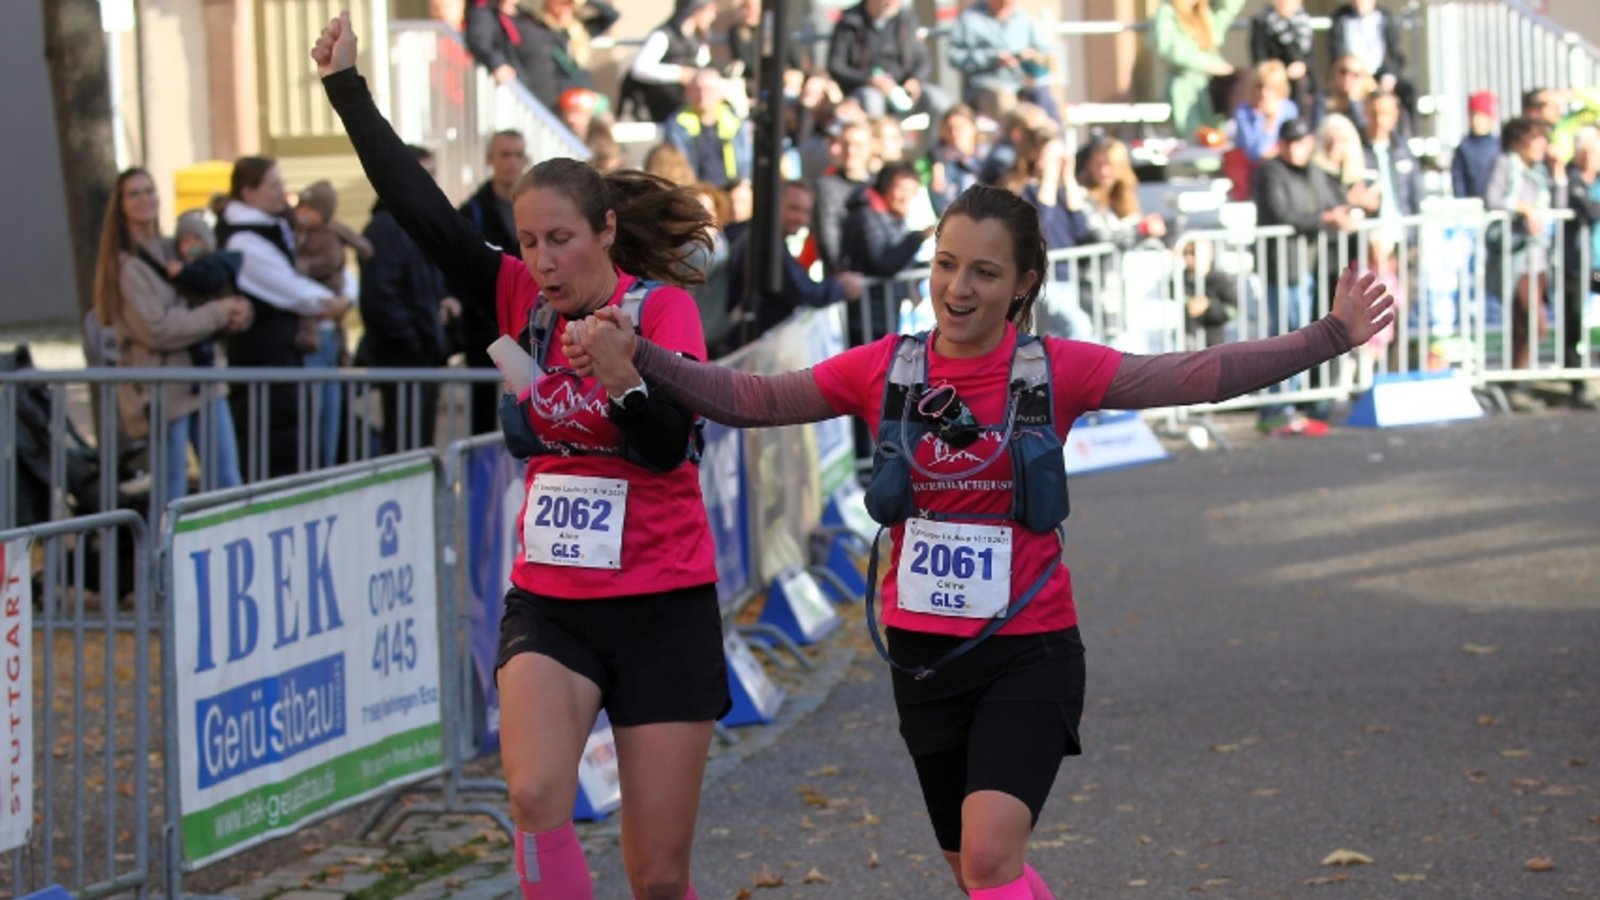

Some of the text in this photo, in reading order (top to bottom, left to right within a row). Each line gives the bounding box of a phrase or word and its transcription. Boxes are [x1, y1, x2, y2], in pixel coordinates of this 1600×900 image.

[535, 495, 612, 532] 2062
[551, 542, 580, 558] GLS
[910, 541, 992, 581] 2061
[190, 515, 344, 674] IBEK
[368, 563, 414, 617] 07042
[930, 592, 966, 609] GLS
[372, 617, 417, 677] 4145
[5, 576, 21, 815] STUTTGART
[204, 677, 335, 777] Gerüstbau
